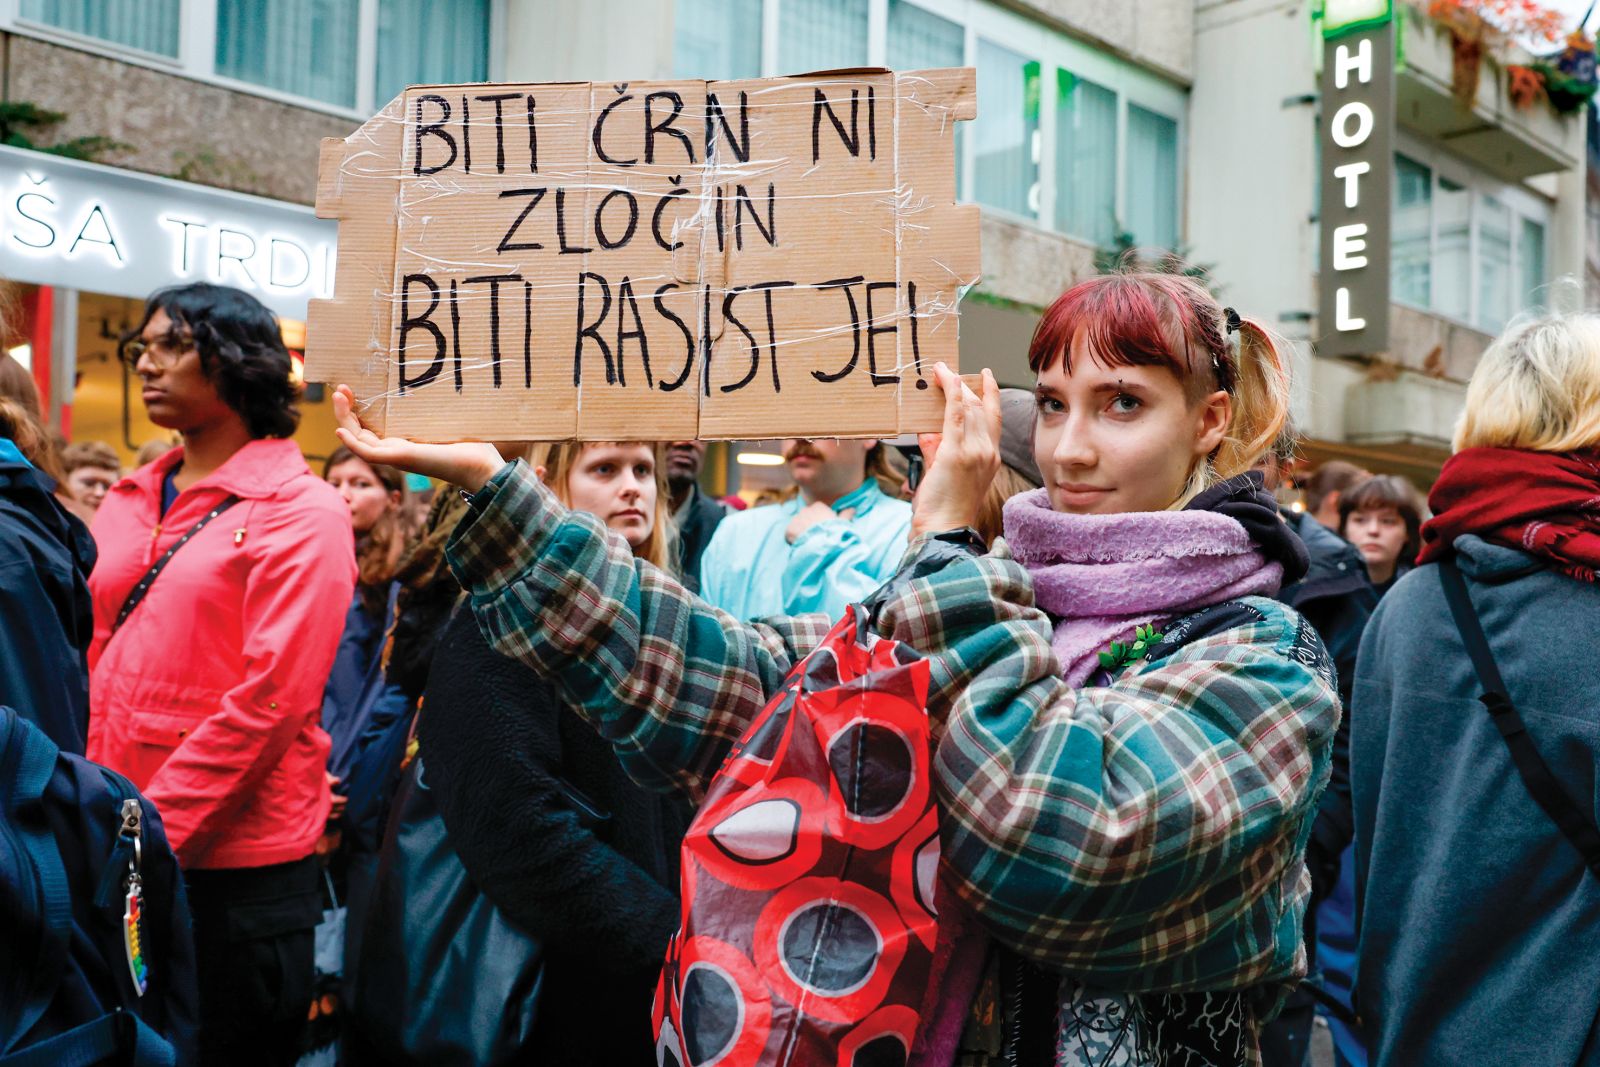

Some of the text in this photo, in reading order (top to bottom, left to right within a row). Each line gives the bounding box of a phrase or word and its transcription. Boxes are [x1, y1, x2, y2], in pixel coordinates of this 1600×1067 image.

[413, 82, 876, 174] BITI ČRN NI
[496, 174, 777, 255] ZLOČIN
[1331, 39, 1373, 332] HOTEL
[397, 271, 928, 397] BITI RASIST JE!
